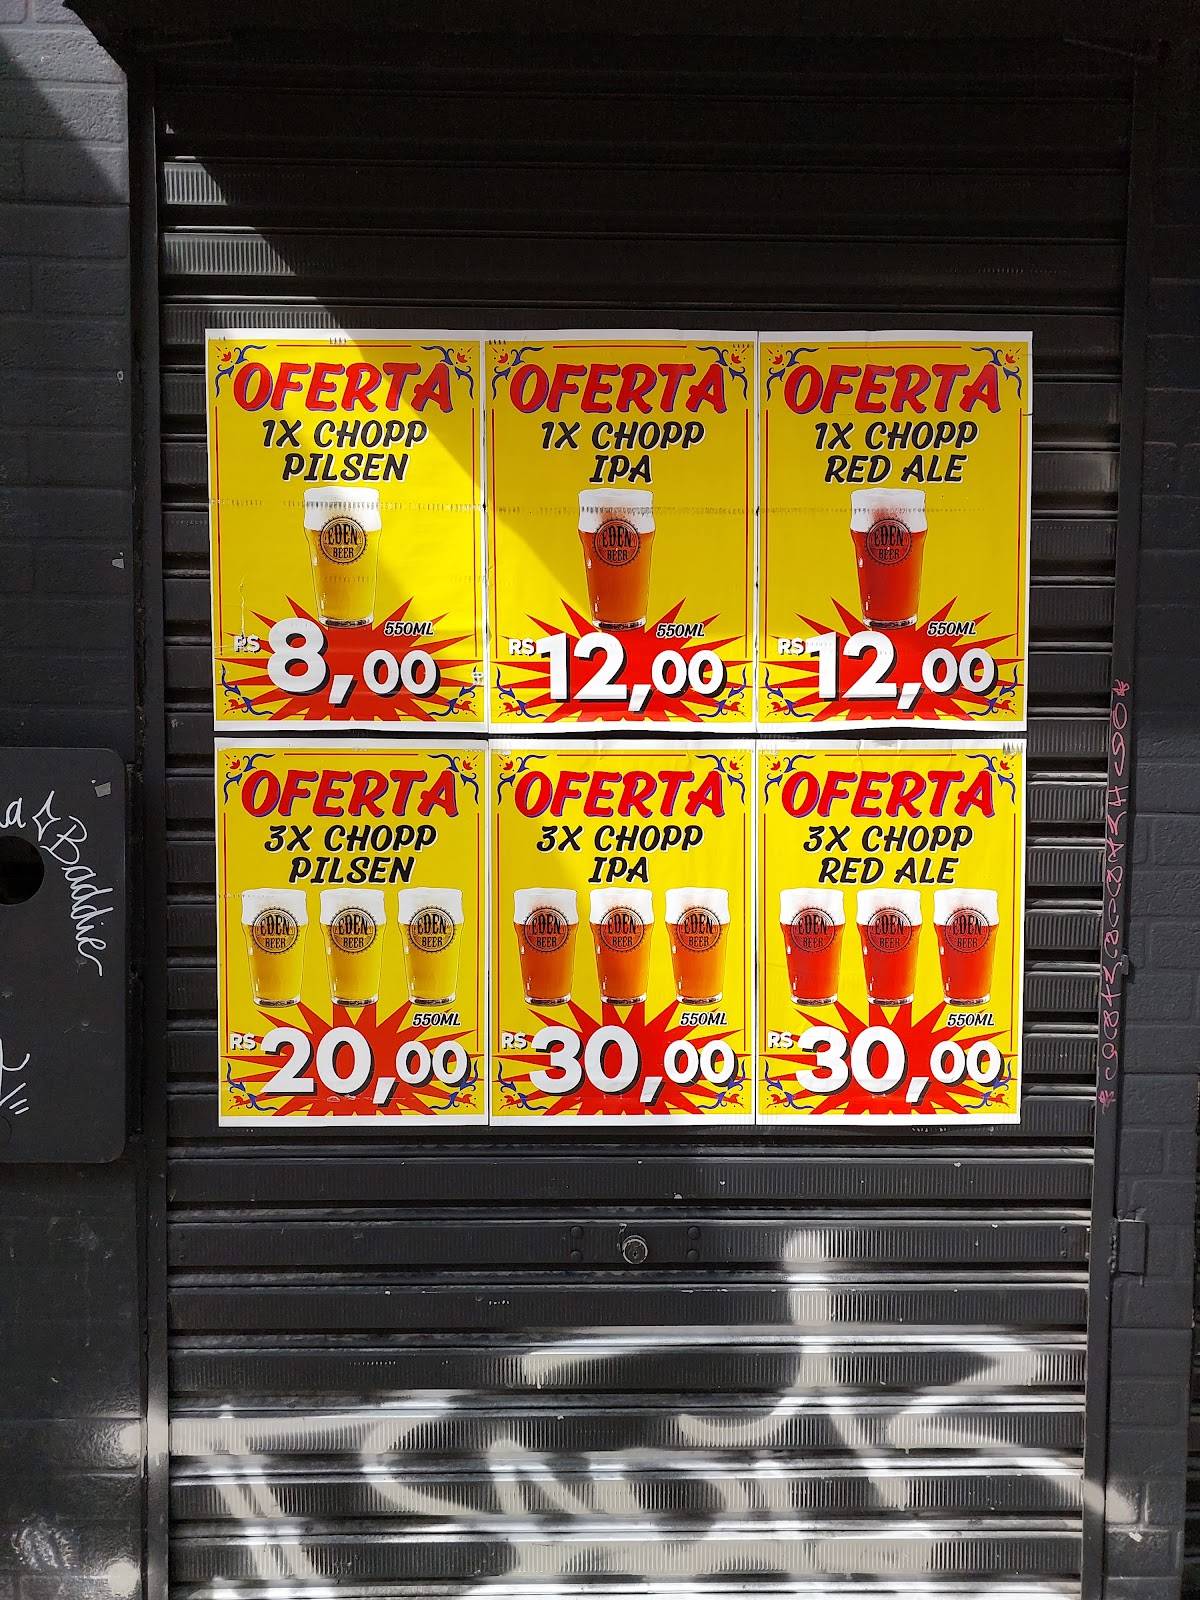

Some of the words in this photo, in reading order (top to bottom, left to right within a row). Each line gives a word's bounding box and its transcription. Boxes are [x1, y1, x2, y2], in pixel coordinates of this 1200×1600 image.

[233, 361, 453, 413] OFERTA
[509, 363, 727, 414] OFERTA
[784, 363, 1002, 415] OFERTA
[262, 419, 302, 448] 1X
[313, 418, 428, 449] CHOPP
[541, 421, 581, 450] 1X
[591, 420, 706, 450] CHOPP
[815, 421, 854, 450] 1X
[864, 420, 978, 450] CHOPP
[282, 452, 409, 482] PILSEN
[589, 454, 653, 483] IPA
[824, 454, 892, 483] RED
[901, 454, 967, 483] ALE
[327, 523, 358, 545] EDEN
[601, 525, 633, 547] EDEN
[873, 525, 904, 547] EDEN
[332, 546, 355, 560] BEER
[607, 549, 629, 562] BEER
[878, 548, 900, 561] BEER
[383, 620, 434, 637] 550ML
[656, 623, 706, 639] 550ML
[927, 621, 976, 637] 550ML
[267, 617, 440, 708] 8,00
[535, 631, 727, 713] 12,00
[805, 630, 999, 712] 12,00
[241, 769, 459, 818] OFERTA
[514, 770, 726, 818] OFERTA
[781, 770, 995, 818] OFERTA
[264, 824, 313, 852] 3X
[323, 824, 437, 852] CHOPP
[536, 825, 583, 852] 3X
[594, 825, 703, 852] CHOPP
[803, 825, 848, 852] 3X
[861, 825, 973, 853] CHOPP
[288, 856, 415, 884] PILSEN
[588, 856, 649, 883] IPA
[818, 857, 884, 884] RED
[893, 857, 959, 884] ALE
[40, 815, 114, 977] Baddie
[260, 916, 290, 936] EDEN
[338, 916, 368, 936] EDEN
[417, 916, 447, 936] EDEN
[531, 916, 561, 936] EDEN
[607, 916, 638, 936] EDEN
[683, 916, 714, 936] EDEN
[797, 916, 827, 936] EDEN
[874, 916, 905, 936] EDEN
[952, 916, 983, 936] EDEN
[265, 937, 286, 948] BEER
[343, 937, 364, 948] BEER
[421, 937, 443, 948] BEER
[536, 937, 557, 948] BEER
[612, 937, 633, 948] BEER
[688, 937, 709, 948] BEER
[803, 937, 824, 948] BEER
[879, 937, 900, 948] BEER
[956, 937, 978, 948] BEER
[412, 1012, 461, 1027] 550ML
[680, 1011, 728, 1027] 550ML
[946, 1012, 995, 1027] 550ML
[260, 1026, 471, 1108] 20,00
[529, 1025, 738, 1105] 30,00
[795, 1025, 1005, 1106] 30,00
